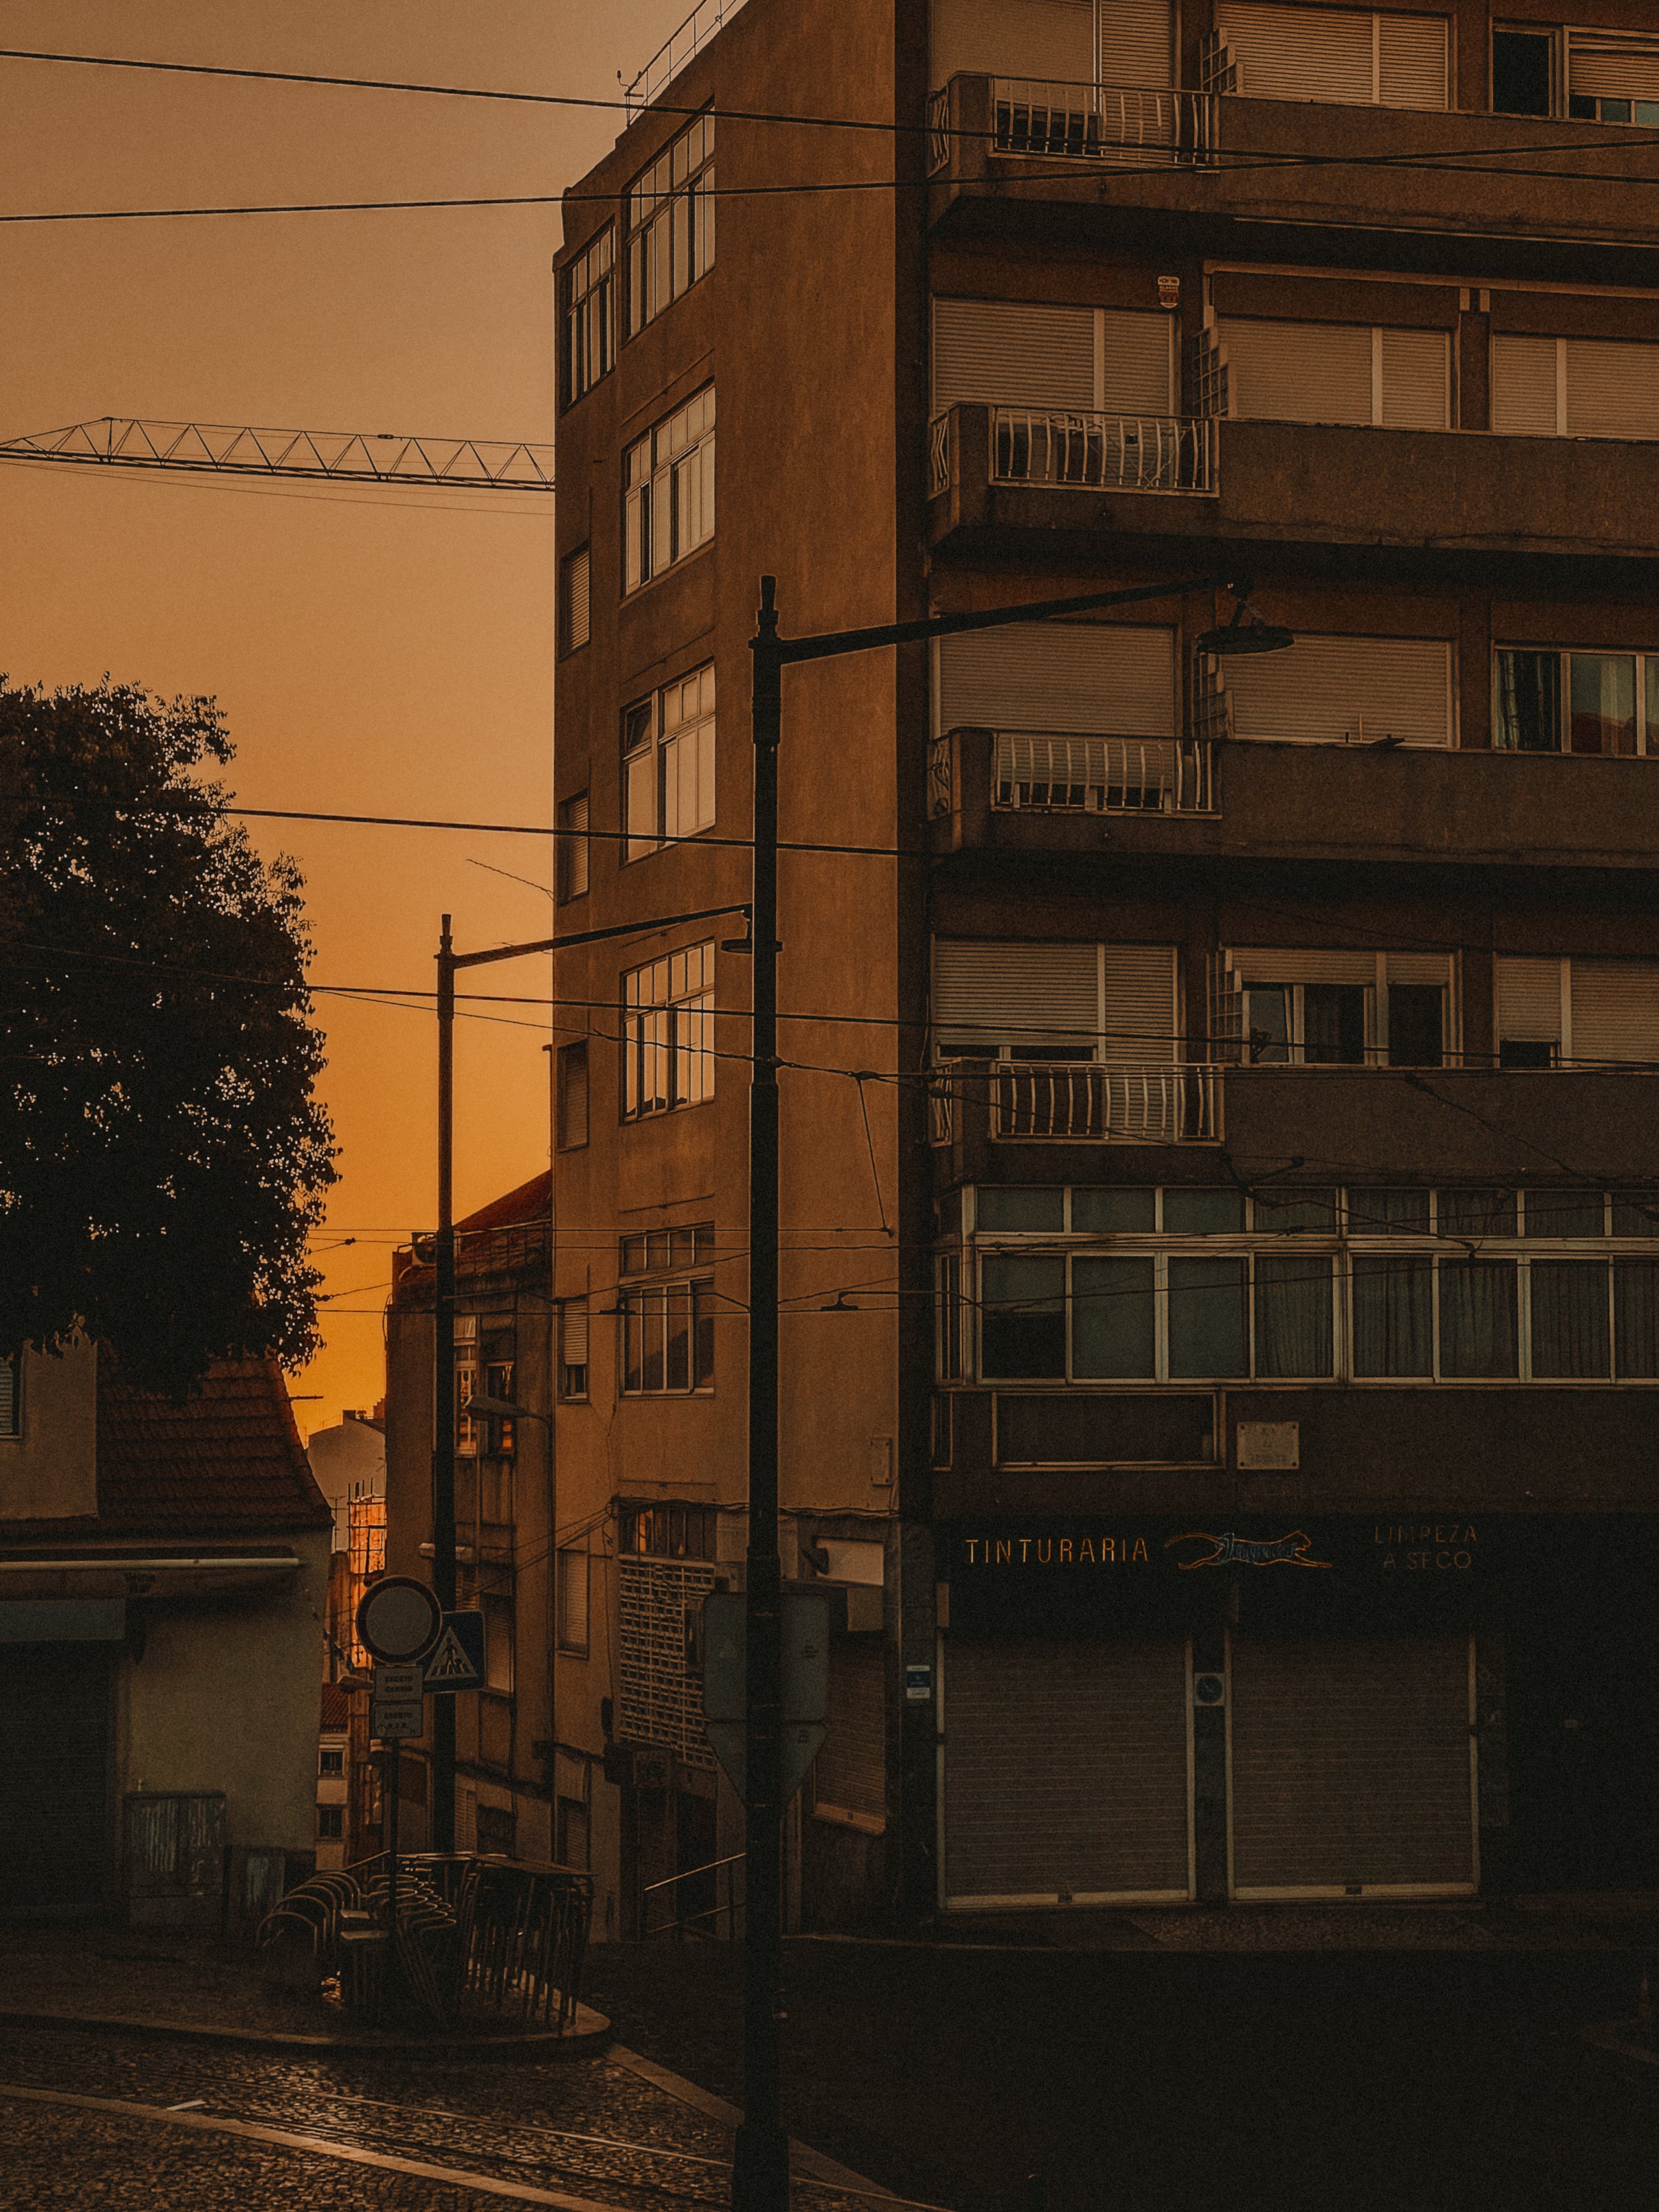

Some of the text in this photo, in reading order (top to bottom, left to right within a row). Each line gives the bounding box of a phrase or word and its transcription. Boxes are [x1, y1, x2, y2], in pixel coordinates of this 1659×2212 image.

[1374, 1524, 1477, 1544] LIMPEZA
[964, 1537, 1148, 1564] TINTURARIA
[1383, 1550, 1471, 1571] A SECO
